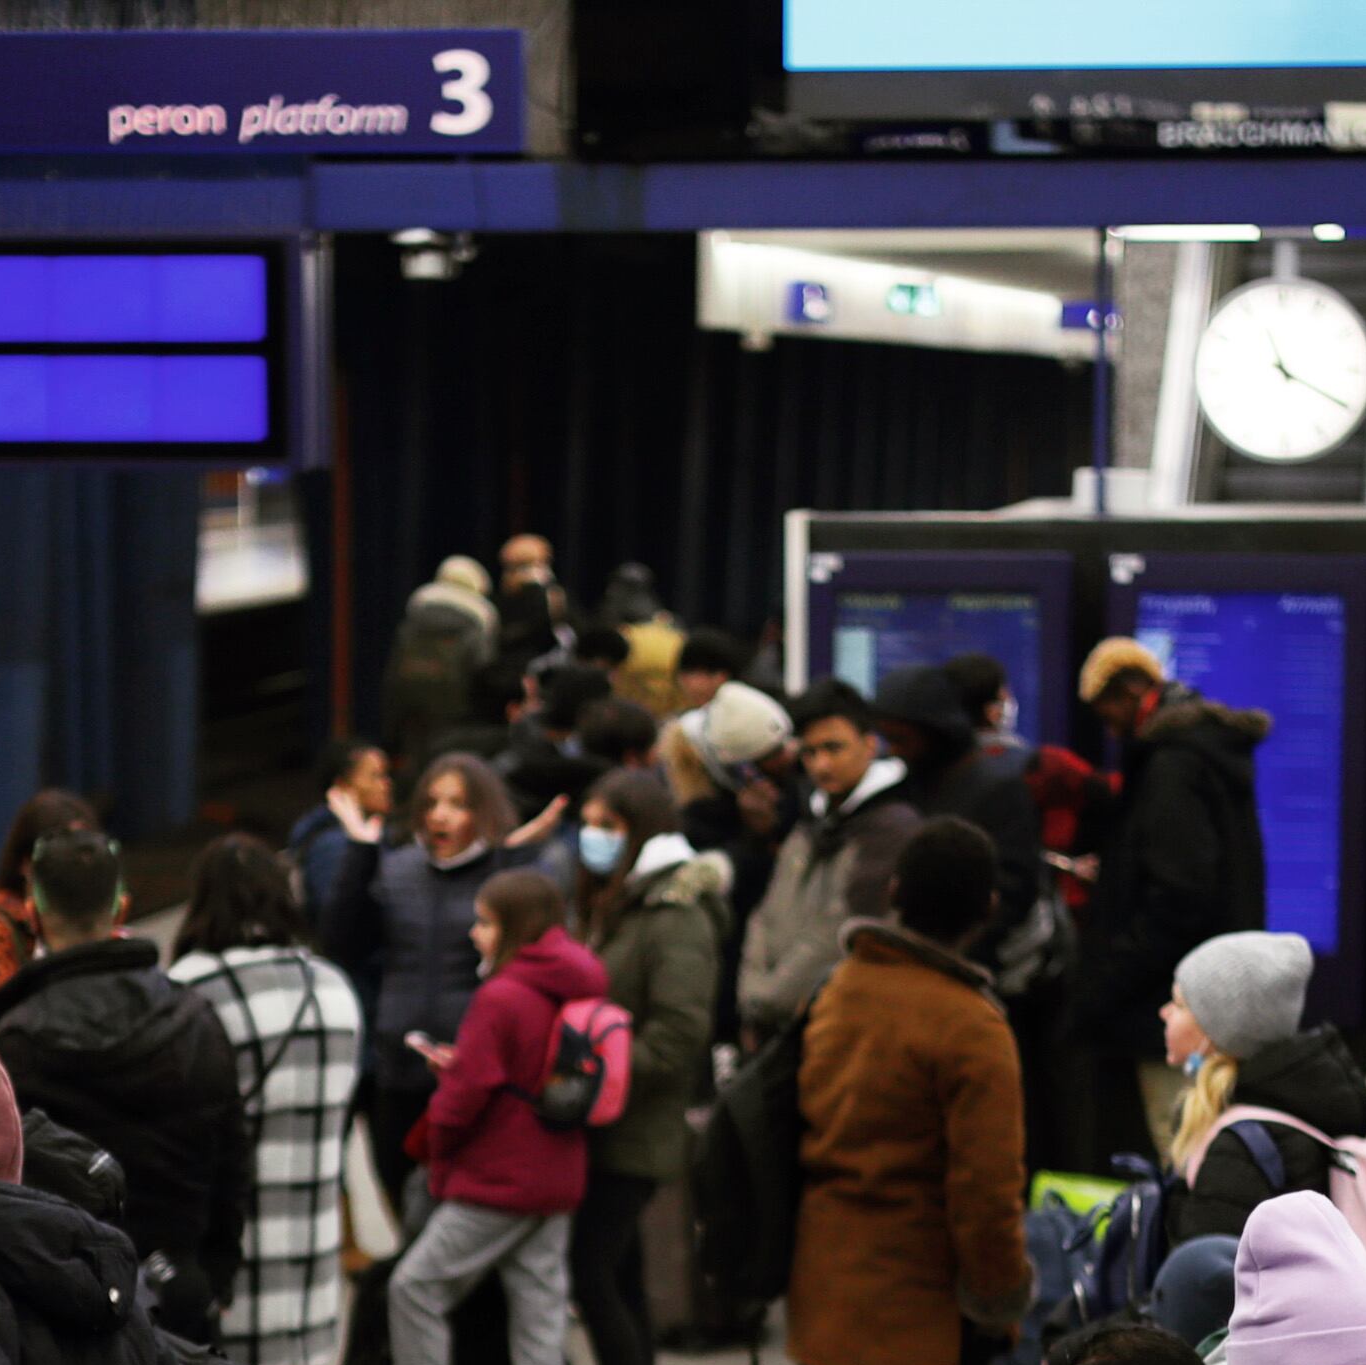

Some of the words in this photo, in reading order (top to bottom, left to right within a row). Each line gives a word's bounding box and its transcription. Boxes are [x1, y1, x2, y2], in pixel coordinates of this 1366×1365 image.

[108, 103, 228, 144] peron
[238, 93, 409, 144] platform
[429, 48, 494, 135] 3
